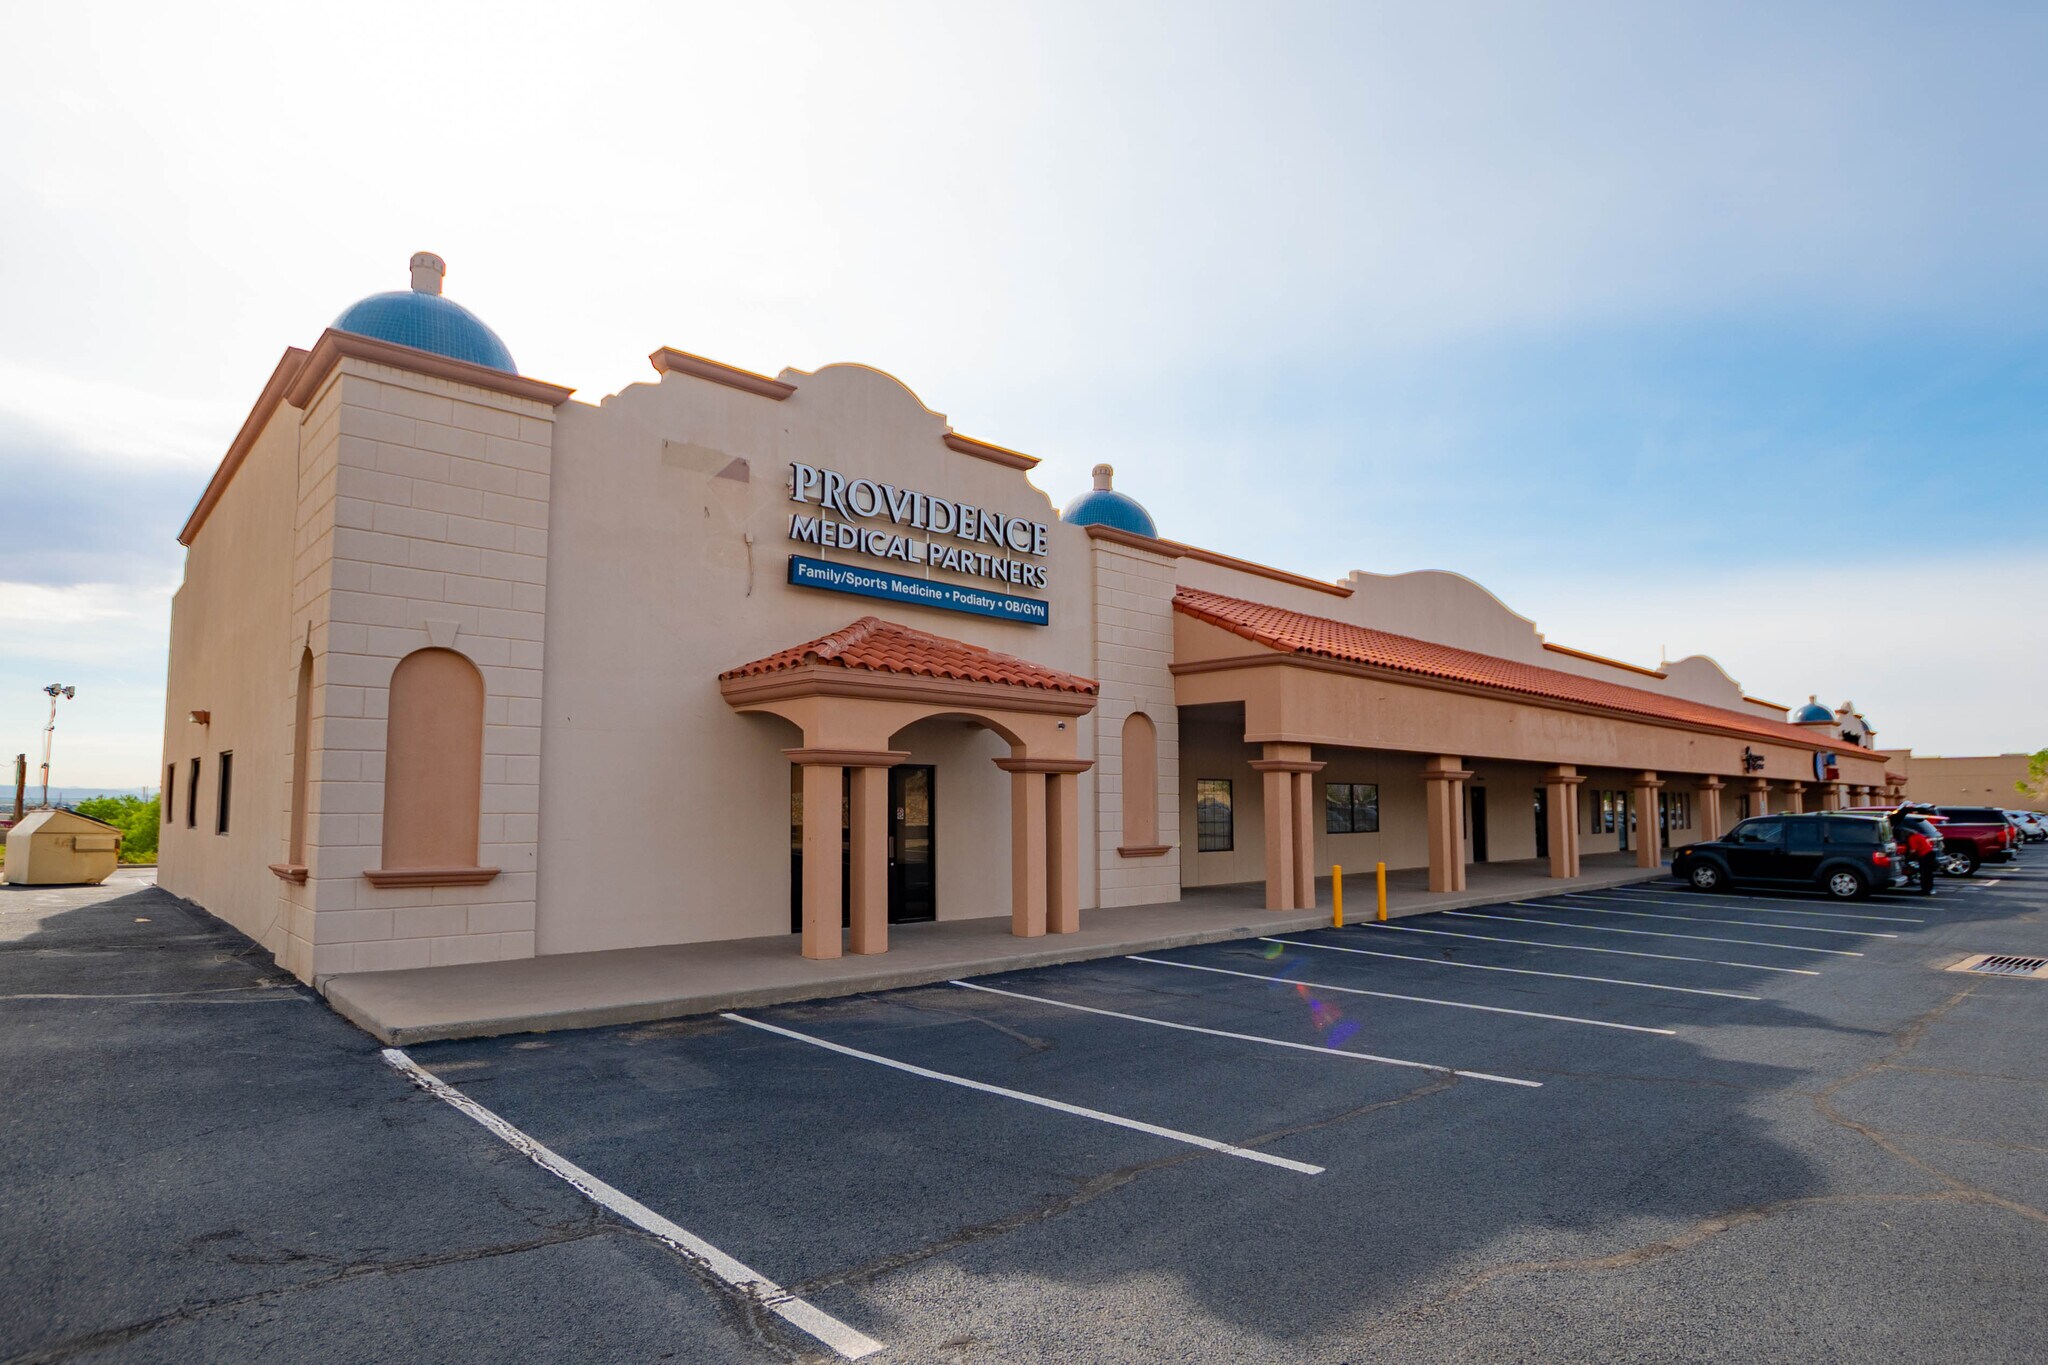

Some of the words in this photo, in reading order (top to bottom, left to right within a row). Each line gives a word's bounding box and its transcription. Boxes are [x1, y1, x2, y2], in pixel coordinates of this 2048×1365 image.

[789, 461, 1048, 557] PROVIDENCE
[789, 513, 921, 564] MEDICAL
[926, 541, 1048, 589] PARTNERS
[798, 563, 888, 590] Family/Sports
[891, 580, 942, 599] Medicine
[952, 590, 996, 611] Podiatry
[1004, 600, 1045, 617] OB/GYN
